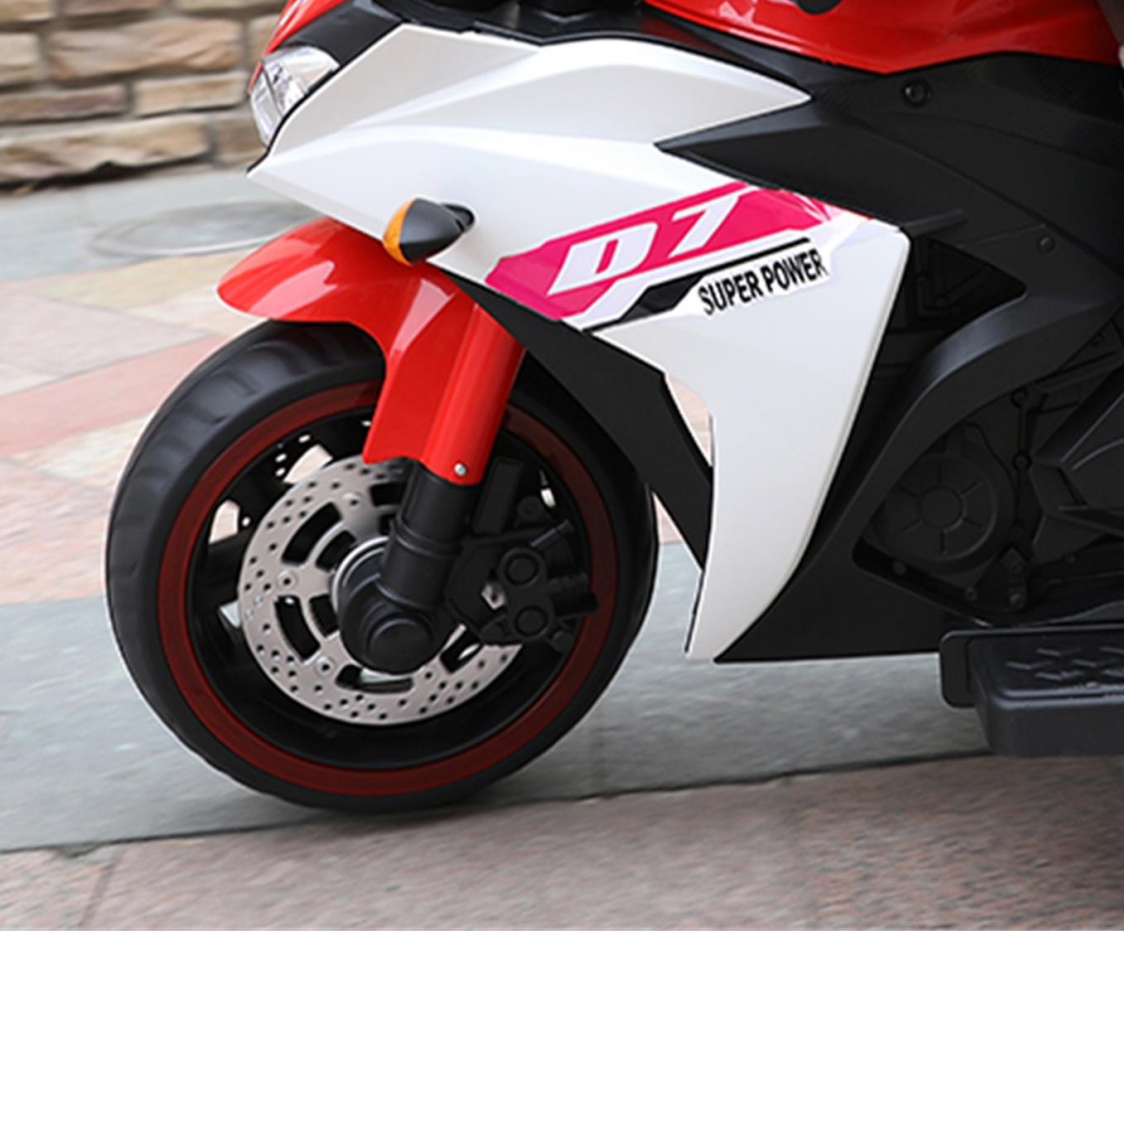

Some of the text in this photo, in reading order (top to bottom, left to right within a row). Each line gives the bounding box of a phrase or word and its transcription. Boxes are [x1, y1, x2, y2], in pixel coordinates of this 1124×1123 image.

[547, 195, 740, 295] D7
[697, 248, 829, 316] SUPER POWER
